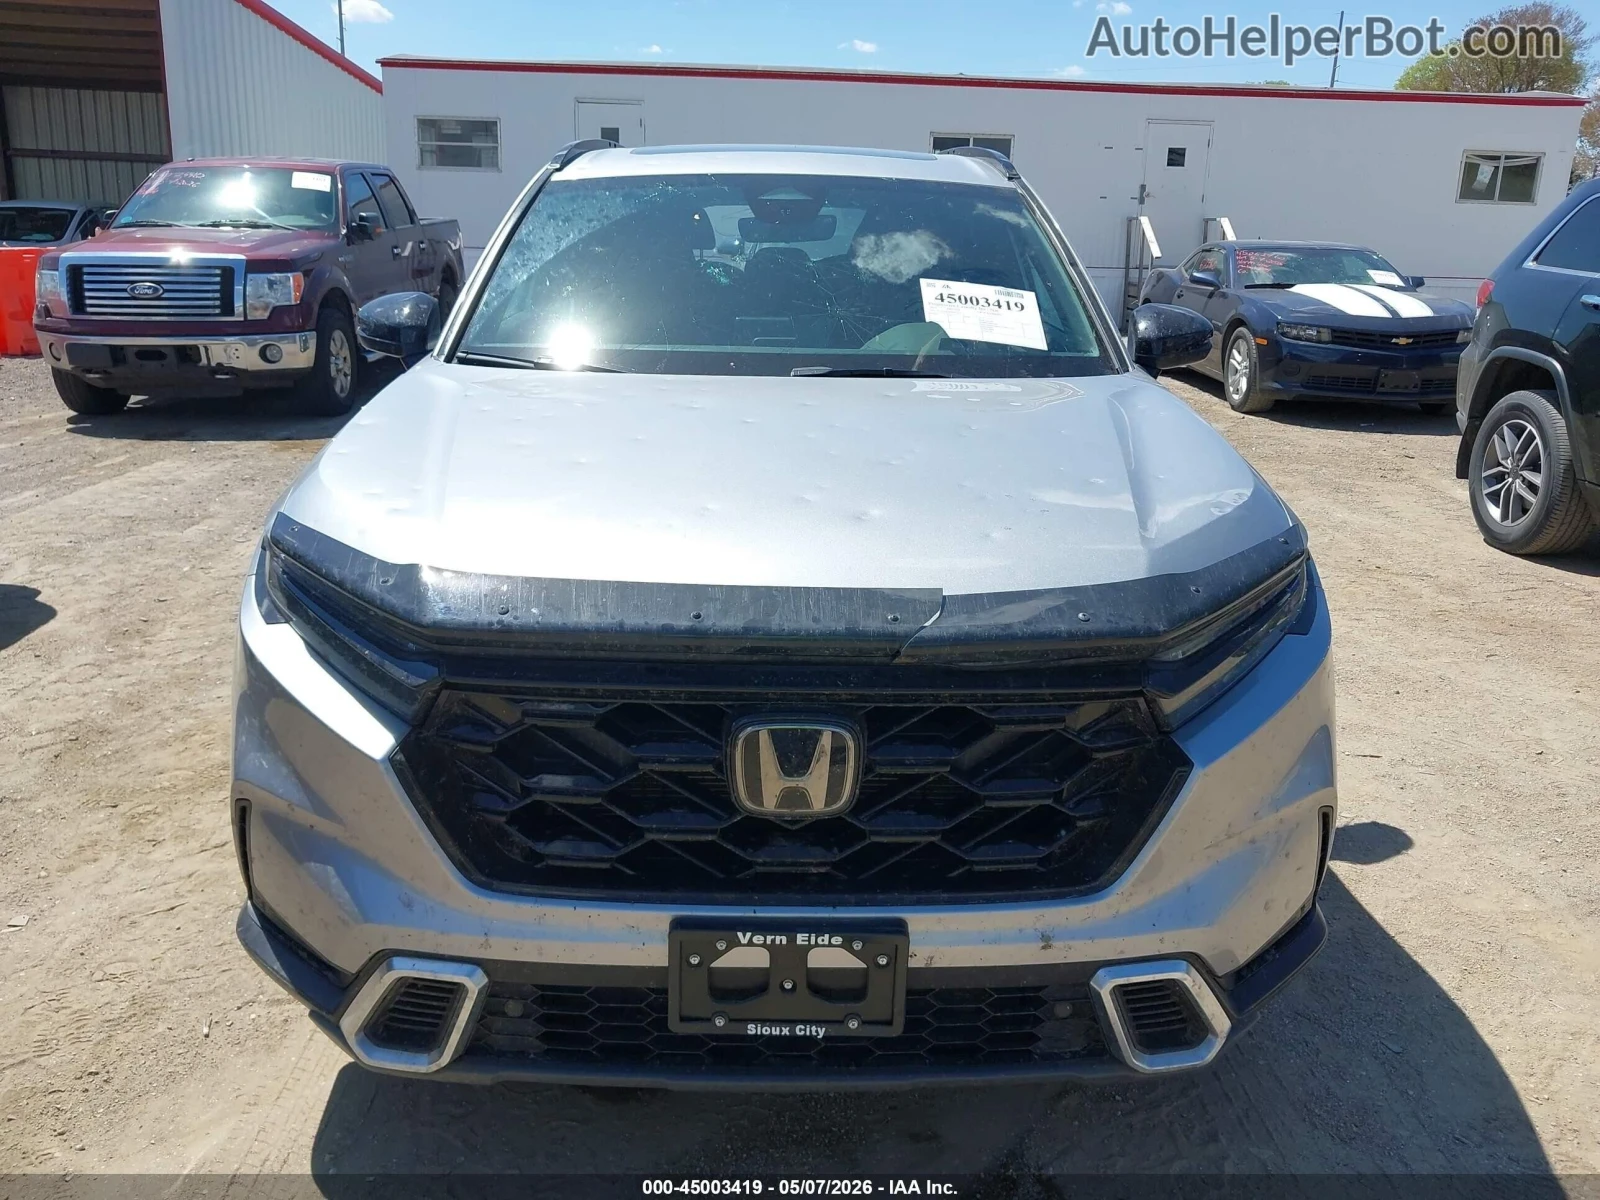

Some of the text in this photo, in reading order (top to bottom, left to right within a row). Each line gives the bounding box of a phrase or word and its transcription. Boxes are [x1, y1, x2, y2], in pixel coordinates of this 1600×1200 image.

[934, 292, 1026, 312] 45003419
[736, 931, 844, 945] Vern Eide
[747, 1024, 826, 1038] Sioux City
